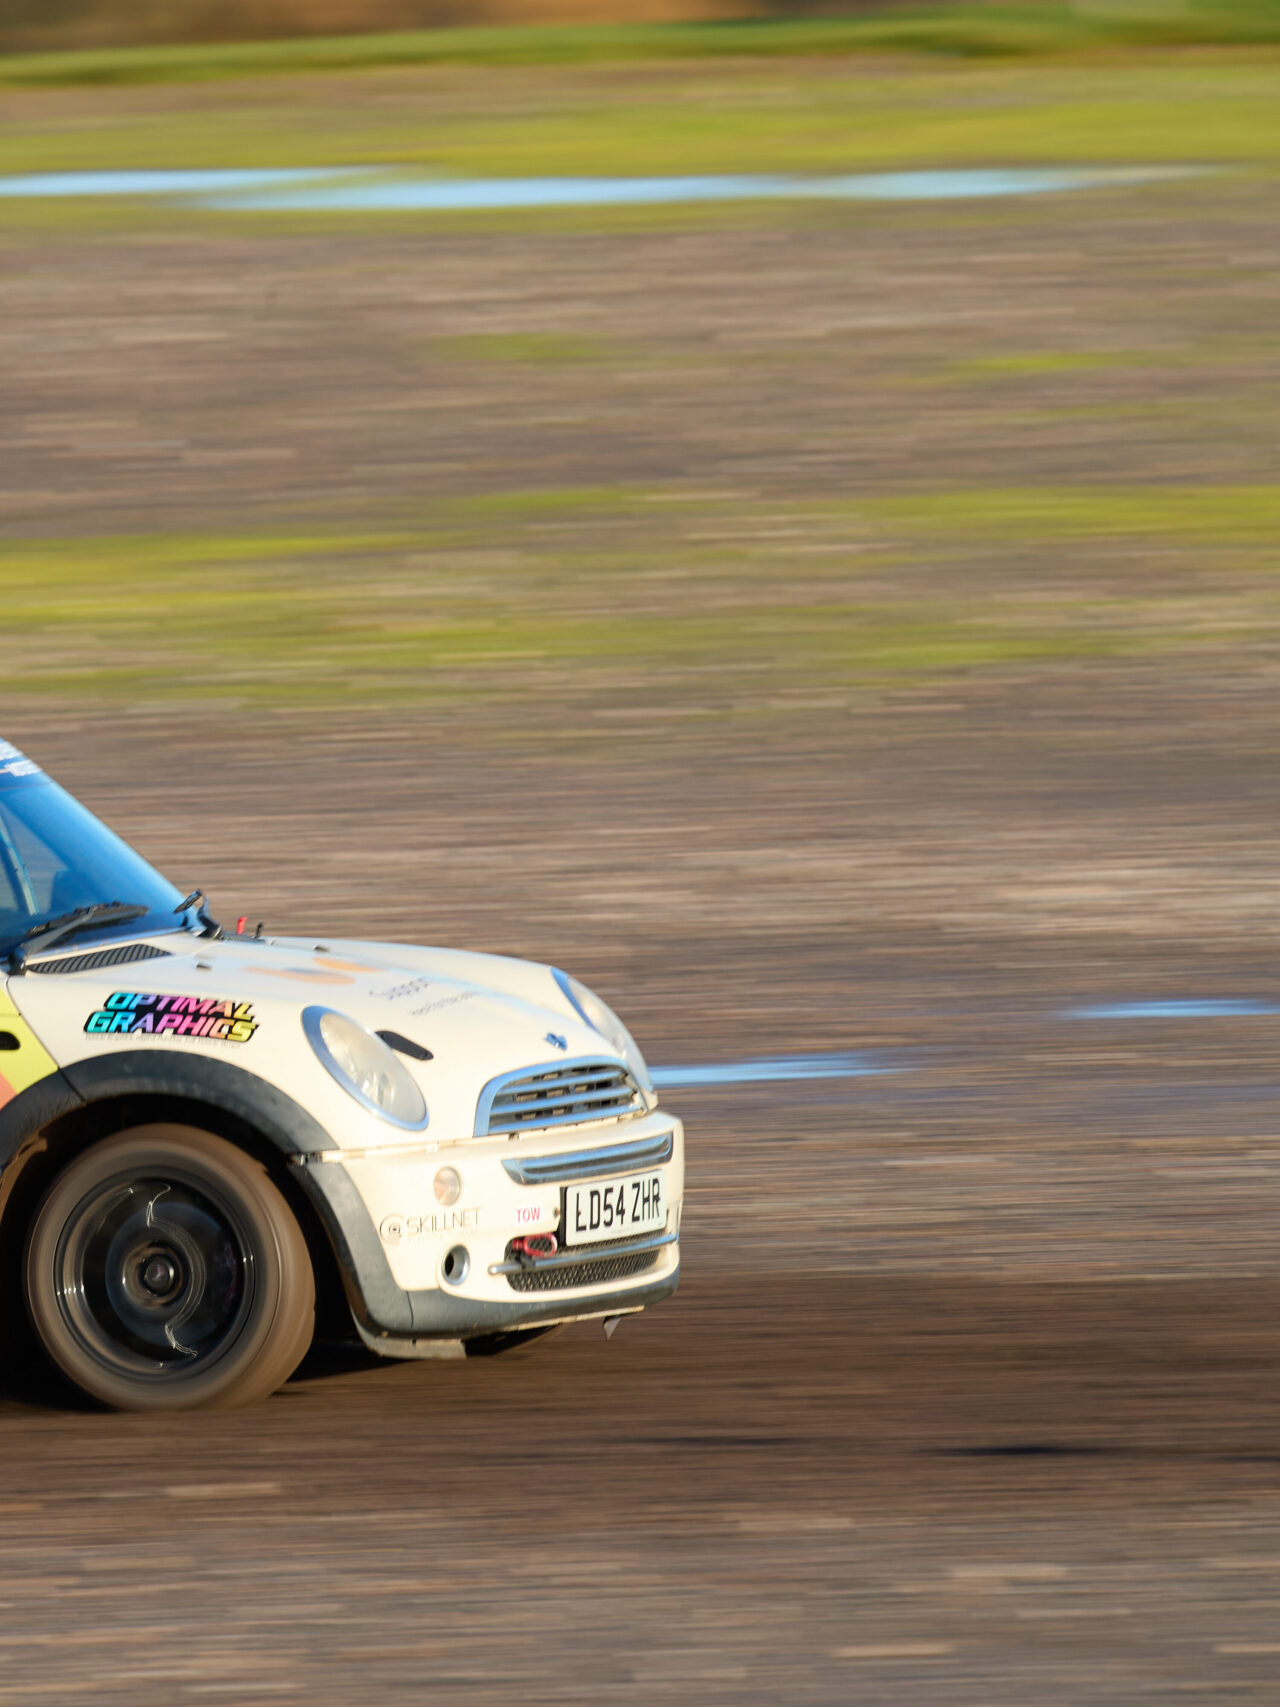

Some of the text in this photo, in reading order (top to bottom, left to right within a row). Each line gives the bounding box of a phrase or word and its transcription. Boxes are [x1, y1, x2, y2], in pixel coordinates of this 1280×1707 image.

[105, 991, 255, 1021] OPTIMAL
[85, 1011, 258, 1042] GRAPHICS
[516, 1207, 541, 1223] TOW
[575, 1177, 661, 1232] LD54 ZHR
[406, 1207, 482, 1235] SKILLNET
